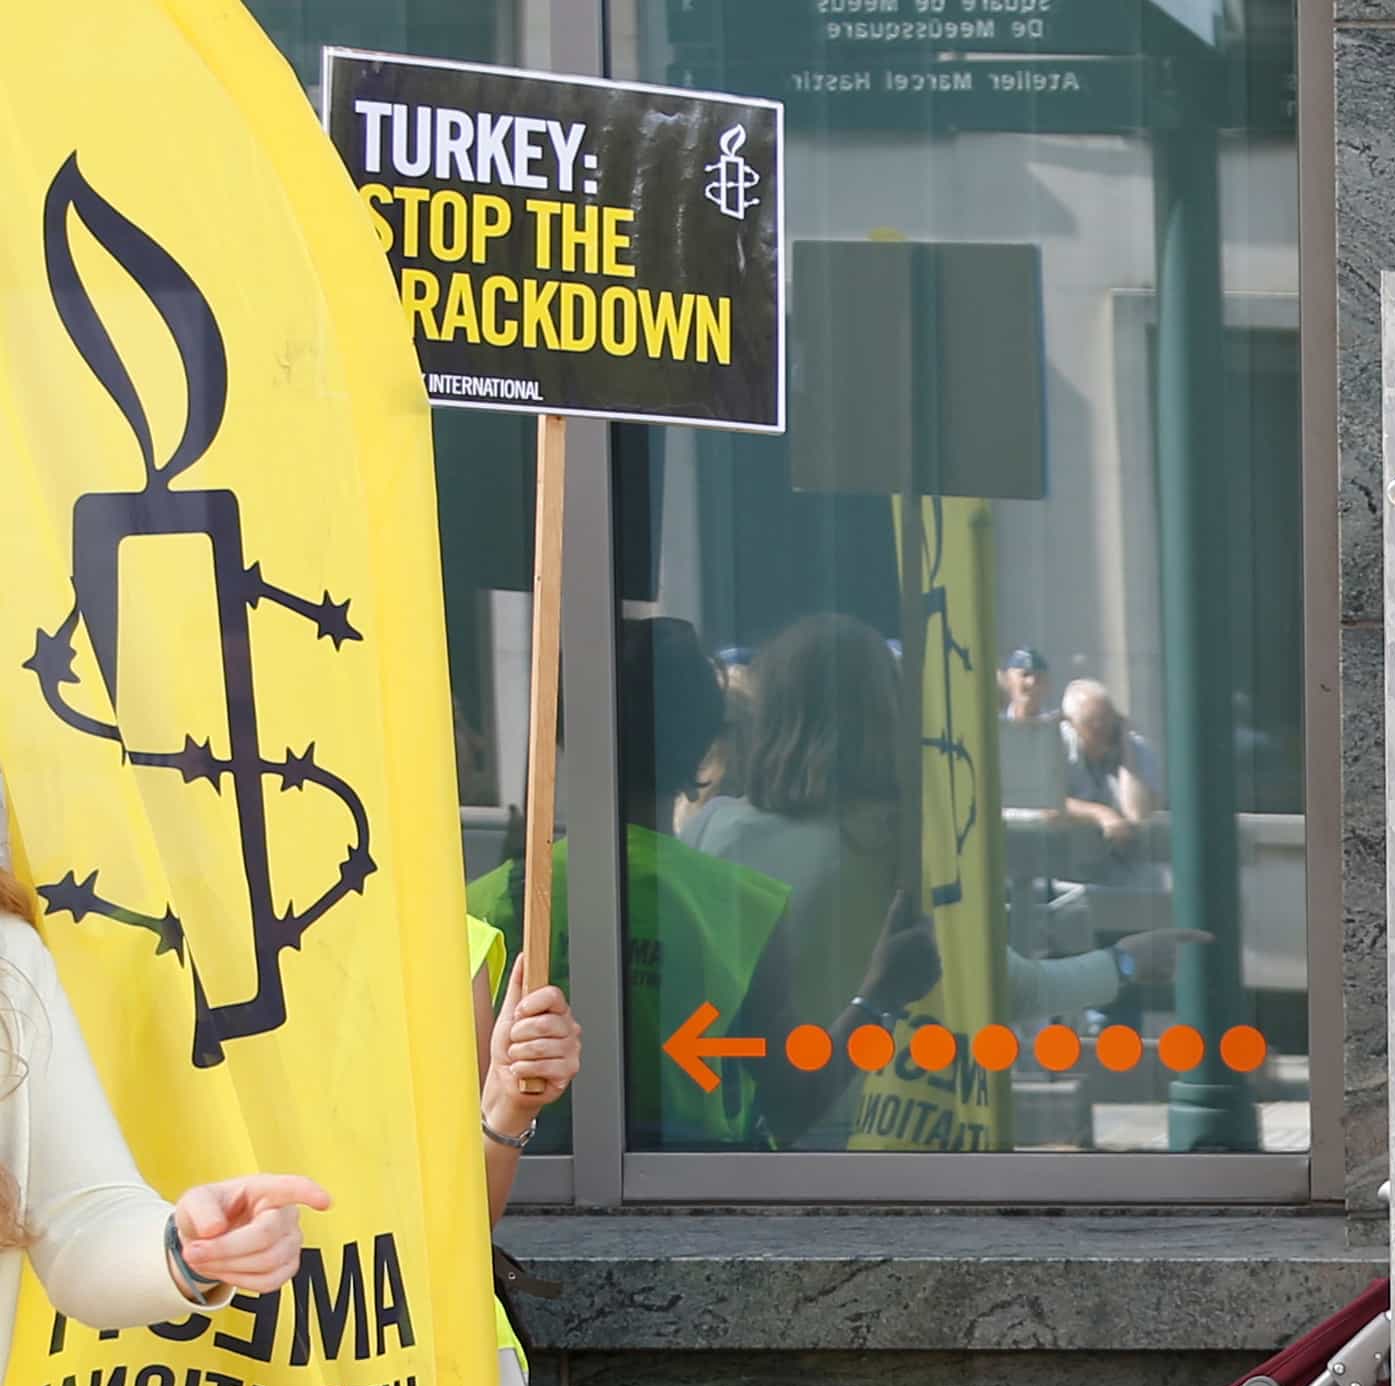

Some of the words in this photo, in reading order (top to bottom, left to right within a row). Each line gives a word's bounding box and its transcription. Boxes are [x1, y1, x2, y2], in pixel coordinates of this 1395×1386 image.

[354, 100, 598, 195] TURKEY:
[359, 183, 512, 264] STOP
[526, 199, 638, 278] THE
[401, 267, 731, 366] RACKDOWN
[428, 373, 544, 401] INTERNATIONAL
